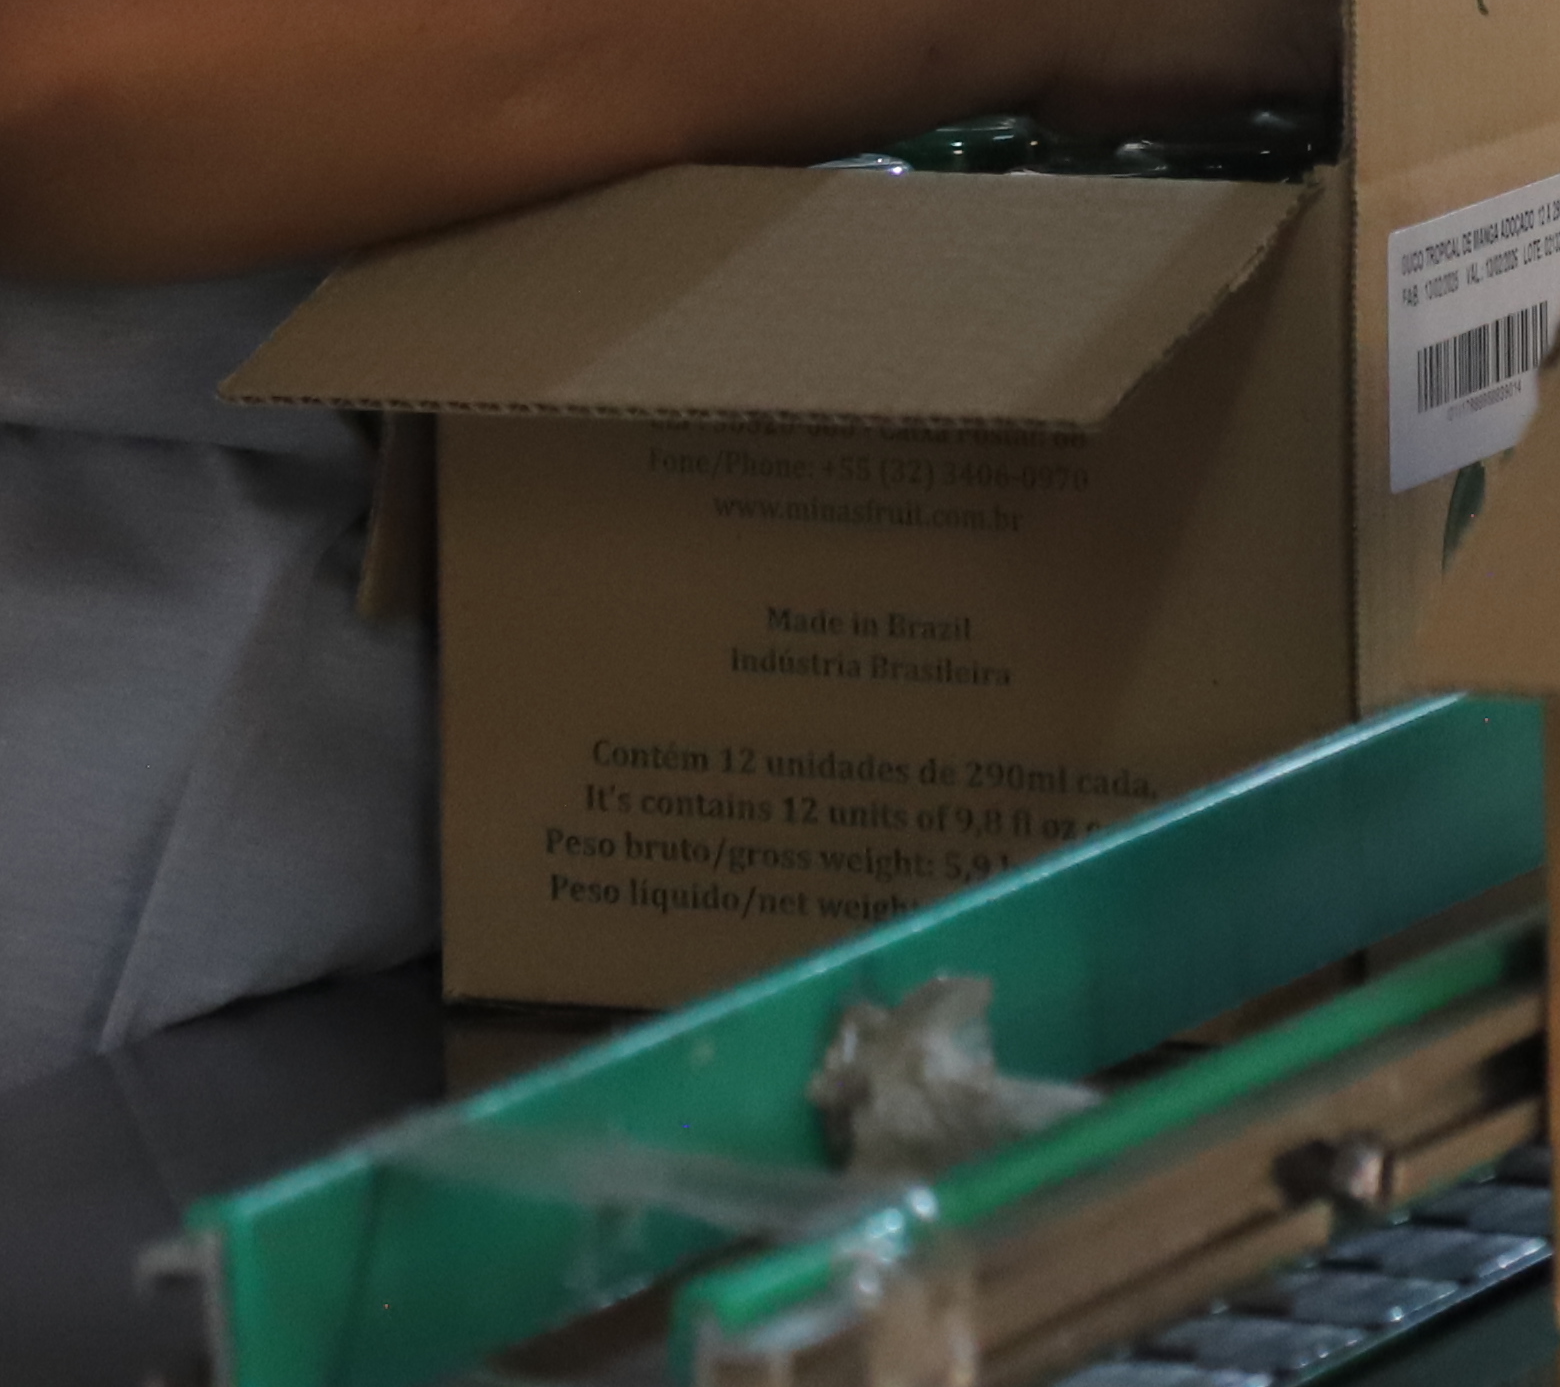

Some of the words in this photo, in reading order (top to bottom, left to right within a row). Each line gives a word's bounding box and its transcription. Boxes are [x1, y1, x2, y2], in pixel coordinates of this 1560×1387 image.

[1462, 231, 1472, 255] DE
[649, 447, 814, 480] Fone/Phone:
[821, 455, 871, 482] +55
[880, 457, 934, 492] (32)
[945, 460, 1088, 492] 3406-0970
[712, 495, 1023, 532] www.minasfruit.com.br
[767, 607, 842, 635] Made
[851, 611, 879, 638] in
[887, 612, 971, 640] Brazil
[731, 647, 861, 679] Indústria
[871, 654, 1011, 687] Brasileira
[591, 739, 709, 772] Contém
[721, 747, 757, 775] 12
[764, 750, 910, 785] unidades
[919, 757, 957, 786] de
[965, 760, 1067, 795] 290ml
[585, 783, 632, 813] It's
[640, 792, 773, 823] contains
[783, 796, 819, 825] 12
[827, 802, 908, 829] units
[916, 804, 950, 833] of
[954, 808, 1003, 839] 9,8
[1041, 818, 1077, 841] oz
[545, 828, 617, 858] Peso
[623, 831, 813, 874] bruto/gross
[819, 847, 935, 883] weight:
[550, 873, 622, 905] Peso
[629, 878, 810, 920] líquido/net
